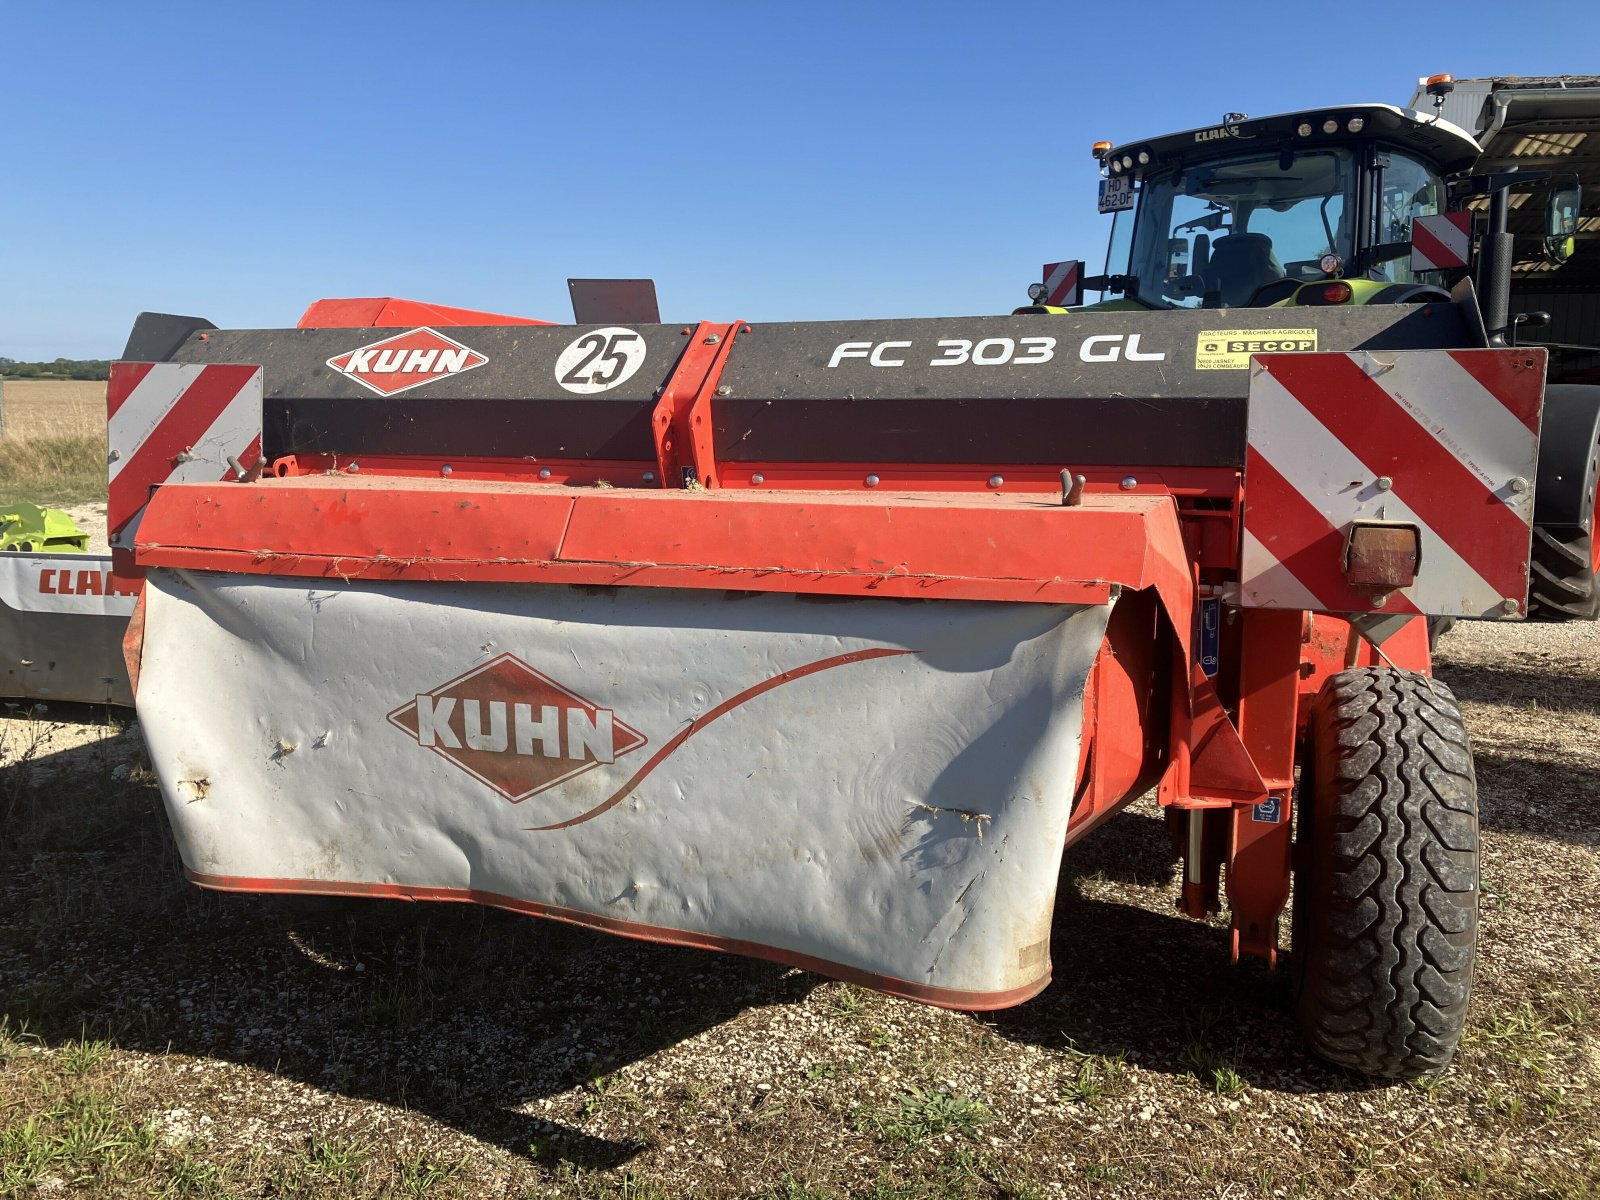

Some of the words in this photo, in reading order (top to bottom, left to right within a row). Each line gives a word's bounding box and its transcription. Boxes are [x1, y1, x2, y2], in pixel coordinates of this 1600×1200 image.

[342, 348, 471, 374] KUHN
[560, 334, 638, 385] 25
[827, 340, 913, 368] FC
[929, 337, 1057, 367] 303
[1079, 334, 1166, 363] GL
[1231, 341, 1312, 352] SECOP
[38, 569, 140, 597] CLA
[416, 695, 614, 764] KUHN
